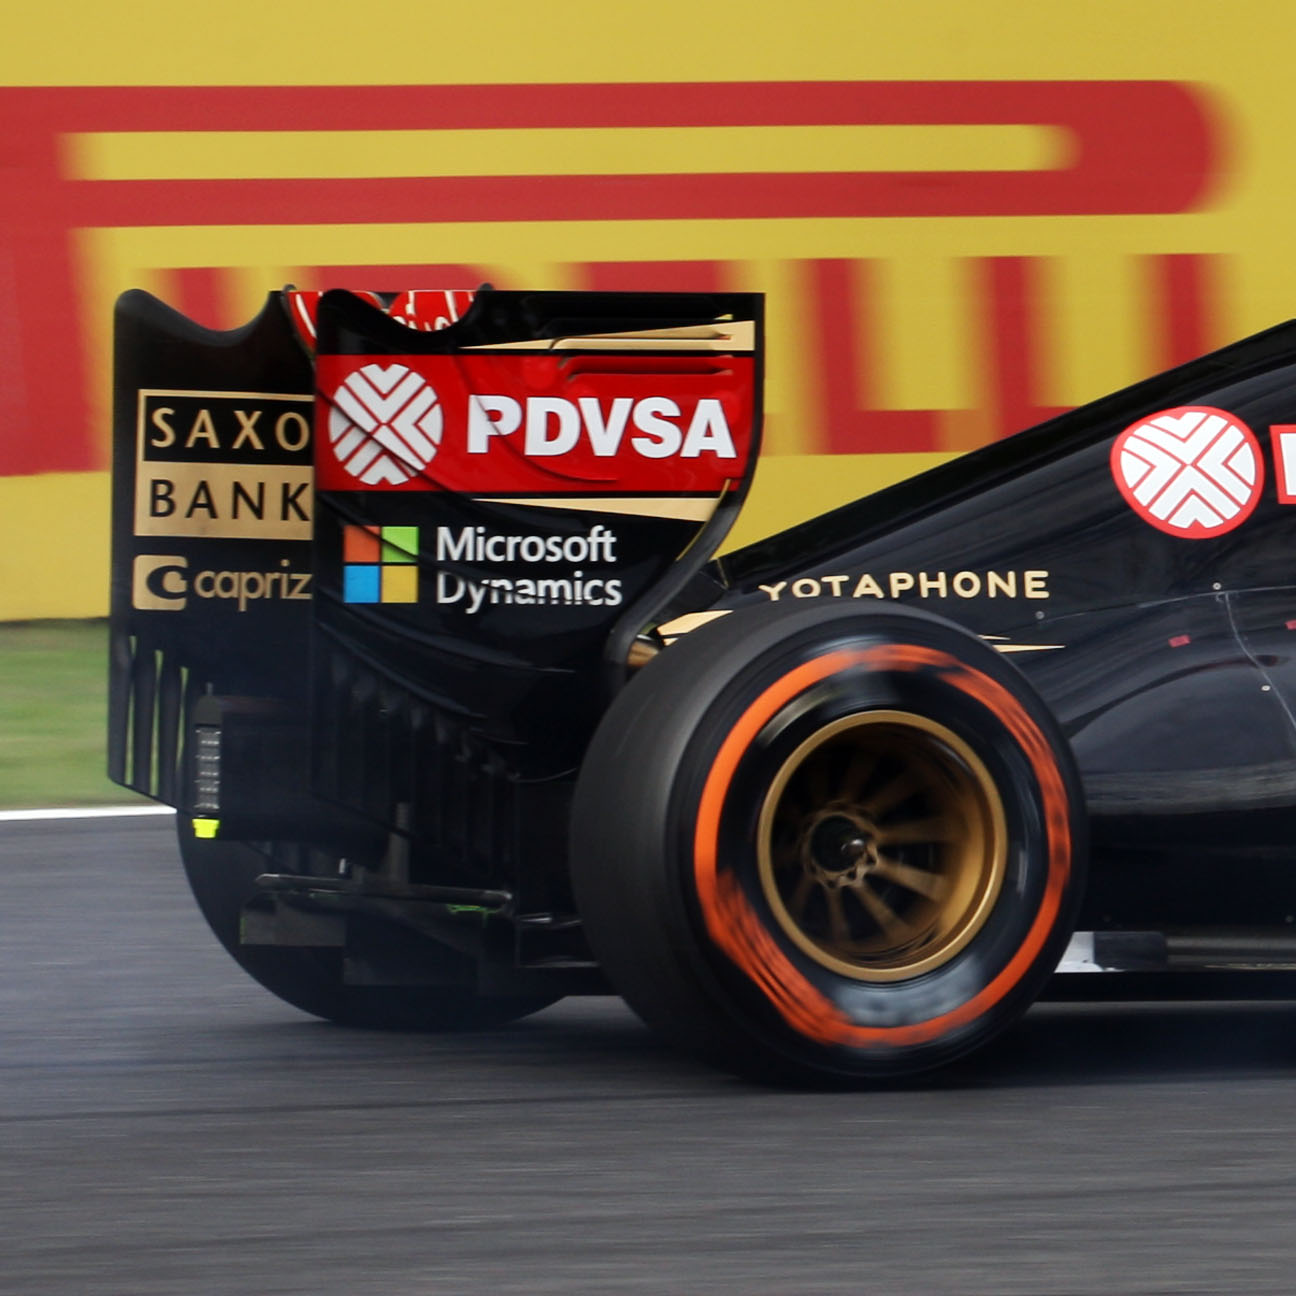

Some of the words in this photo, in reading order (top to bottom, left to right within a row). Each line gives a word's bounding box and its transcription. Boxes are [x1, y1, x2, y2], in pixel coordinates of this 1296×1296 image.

[150, 407, 310, 452] SAXO
[467, 394, 738, 459] PDVSA
[149, 478, 311, 522] BANK
[436, 524, 617, 562] Microsoft
[436, 569, 623, 615] Dynamics
[758, 569, 1050, 602] YOTAPHONE
